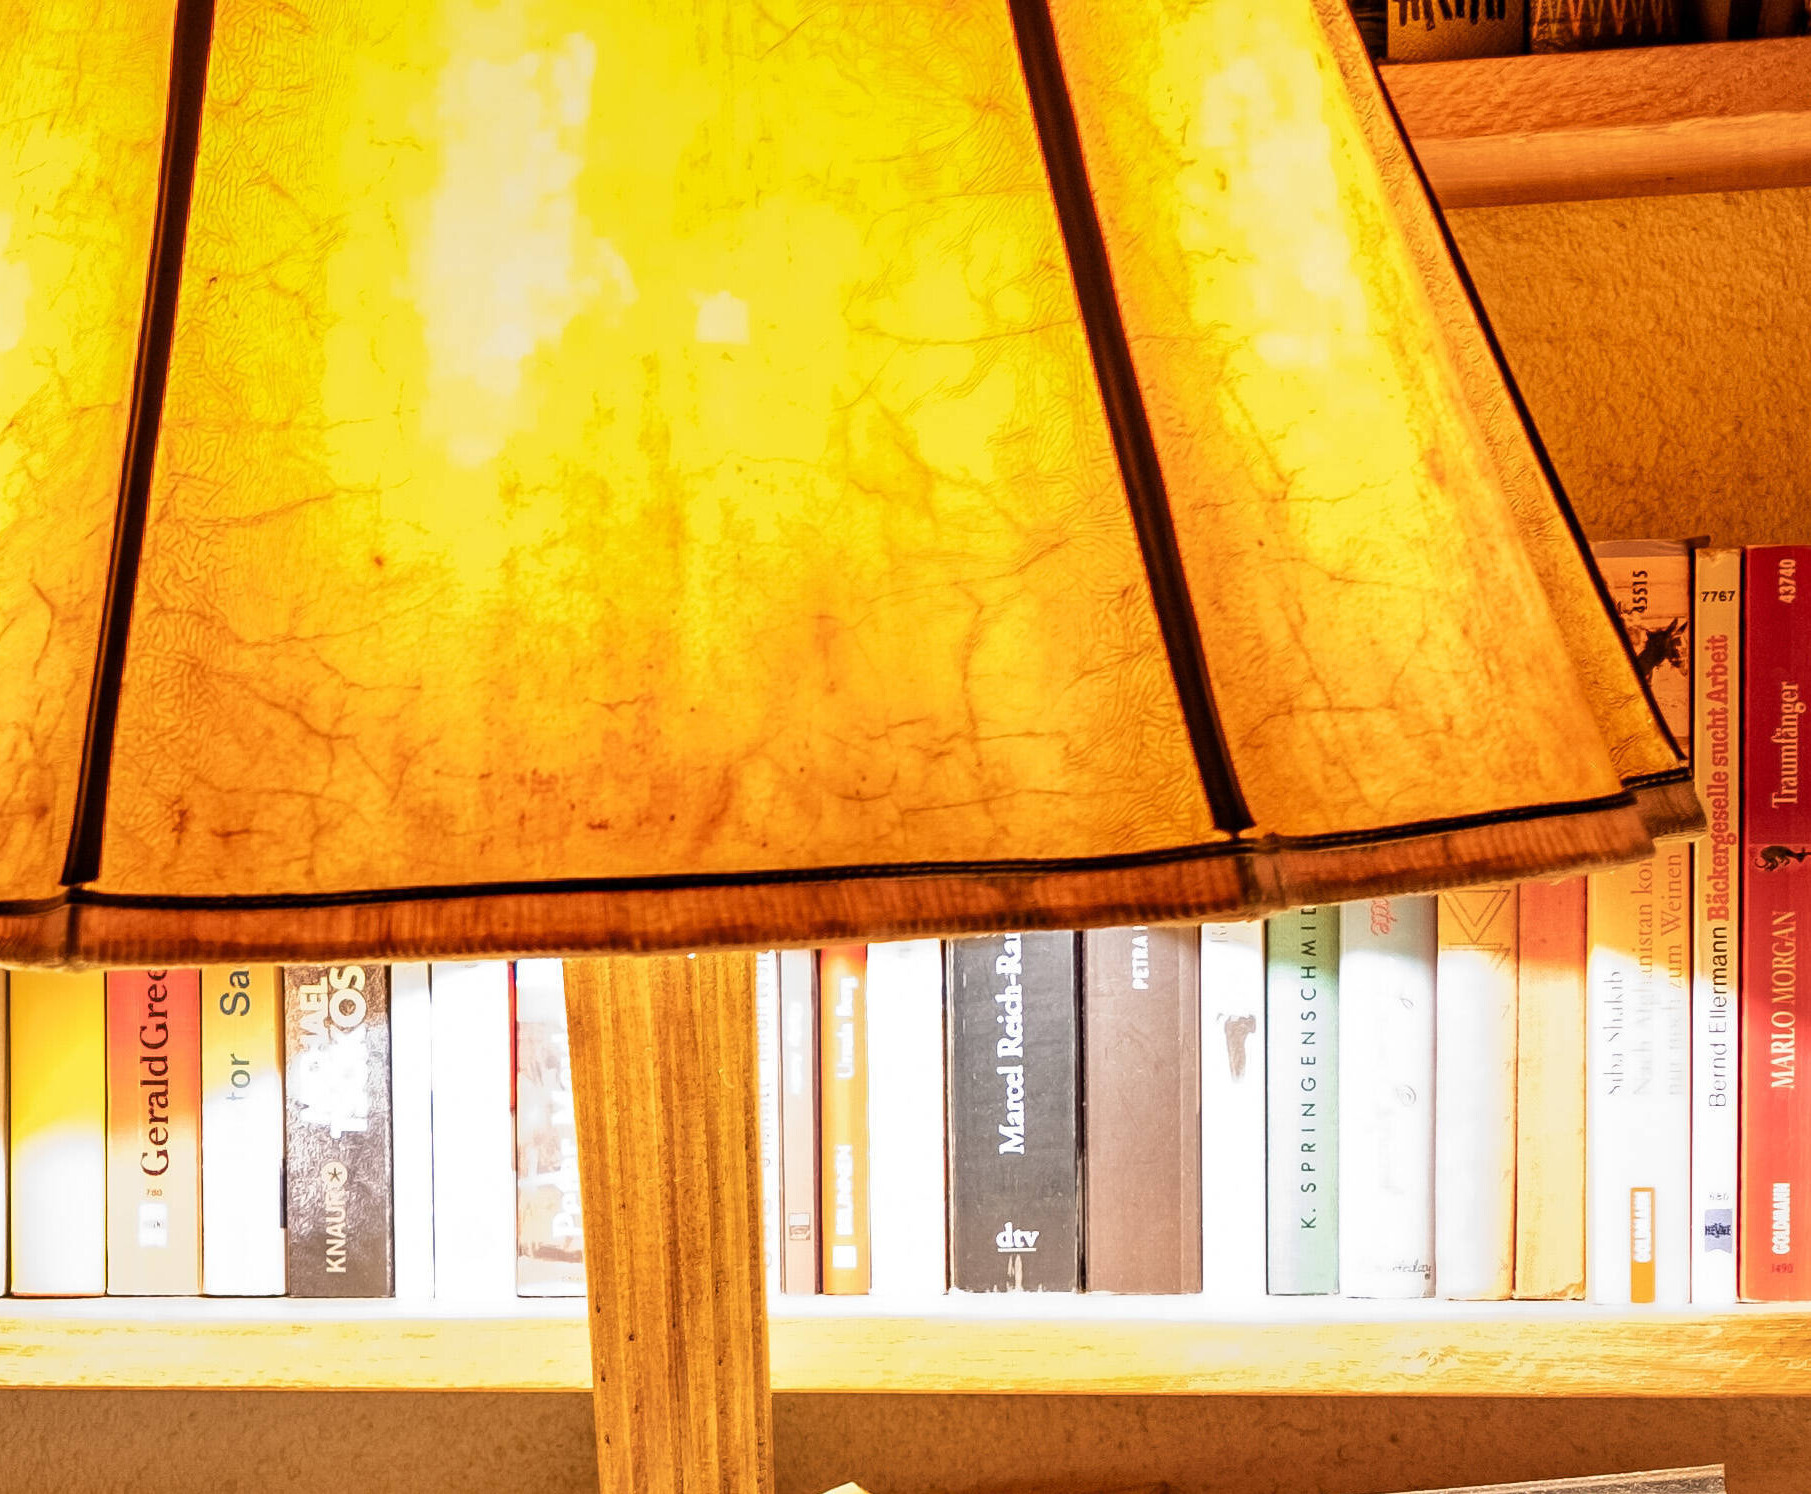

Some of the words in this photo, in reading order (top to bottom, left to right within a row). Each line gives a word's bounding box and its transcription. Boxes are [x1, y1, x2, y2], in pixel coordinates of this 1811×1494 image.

[1701, 590, 1735, 602] 7767
[1779, 558, 1797, 603] 43740
[1705, 634, 1729, 706] Arbeit
[1705, 707, 1729, 767] sucht
[1771, 681, 1807, 808] Traumfänger
[1705, 771, 1737, 921] Bäckergeselle
[1660, 854, 1683, 937] Weinen
[1131, 935, 1149, 990] PETRA
[1707, 927, 1728, 1033] Ellermann
[1770, 910, 1797, 1004] MORGAN
[1708, 1043, 1728, 1108] Bernd
[1770, 1010, 1796, 1088] MARLO
[139, 1055, 169, 1177] Gerald
[995, 1064, 1026, 1155] Marcel
[324, 1189, 347, 1273] KNAUR
[996, 1222, 1040, 1249] dtv
[1300, 1208, 1317, 1229] K.
